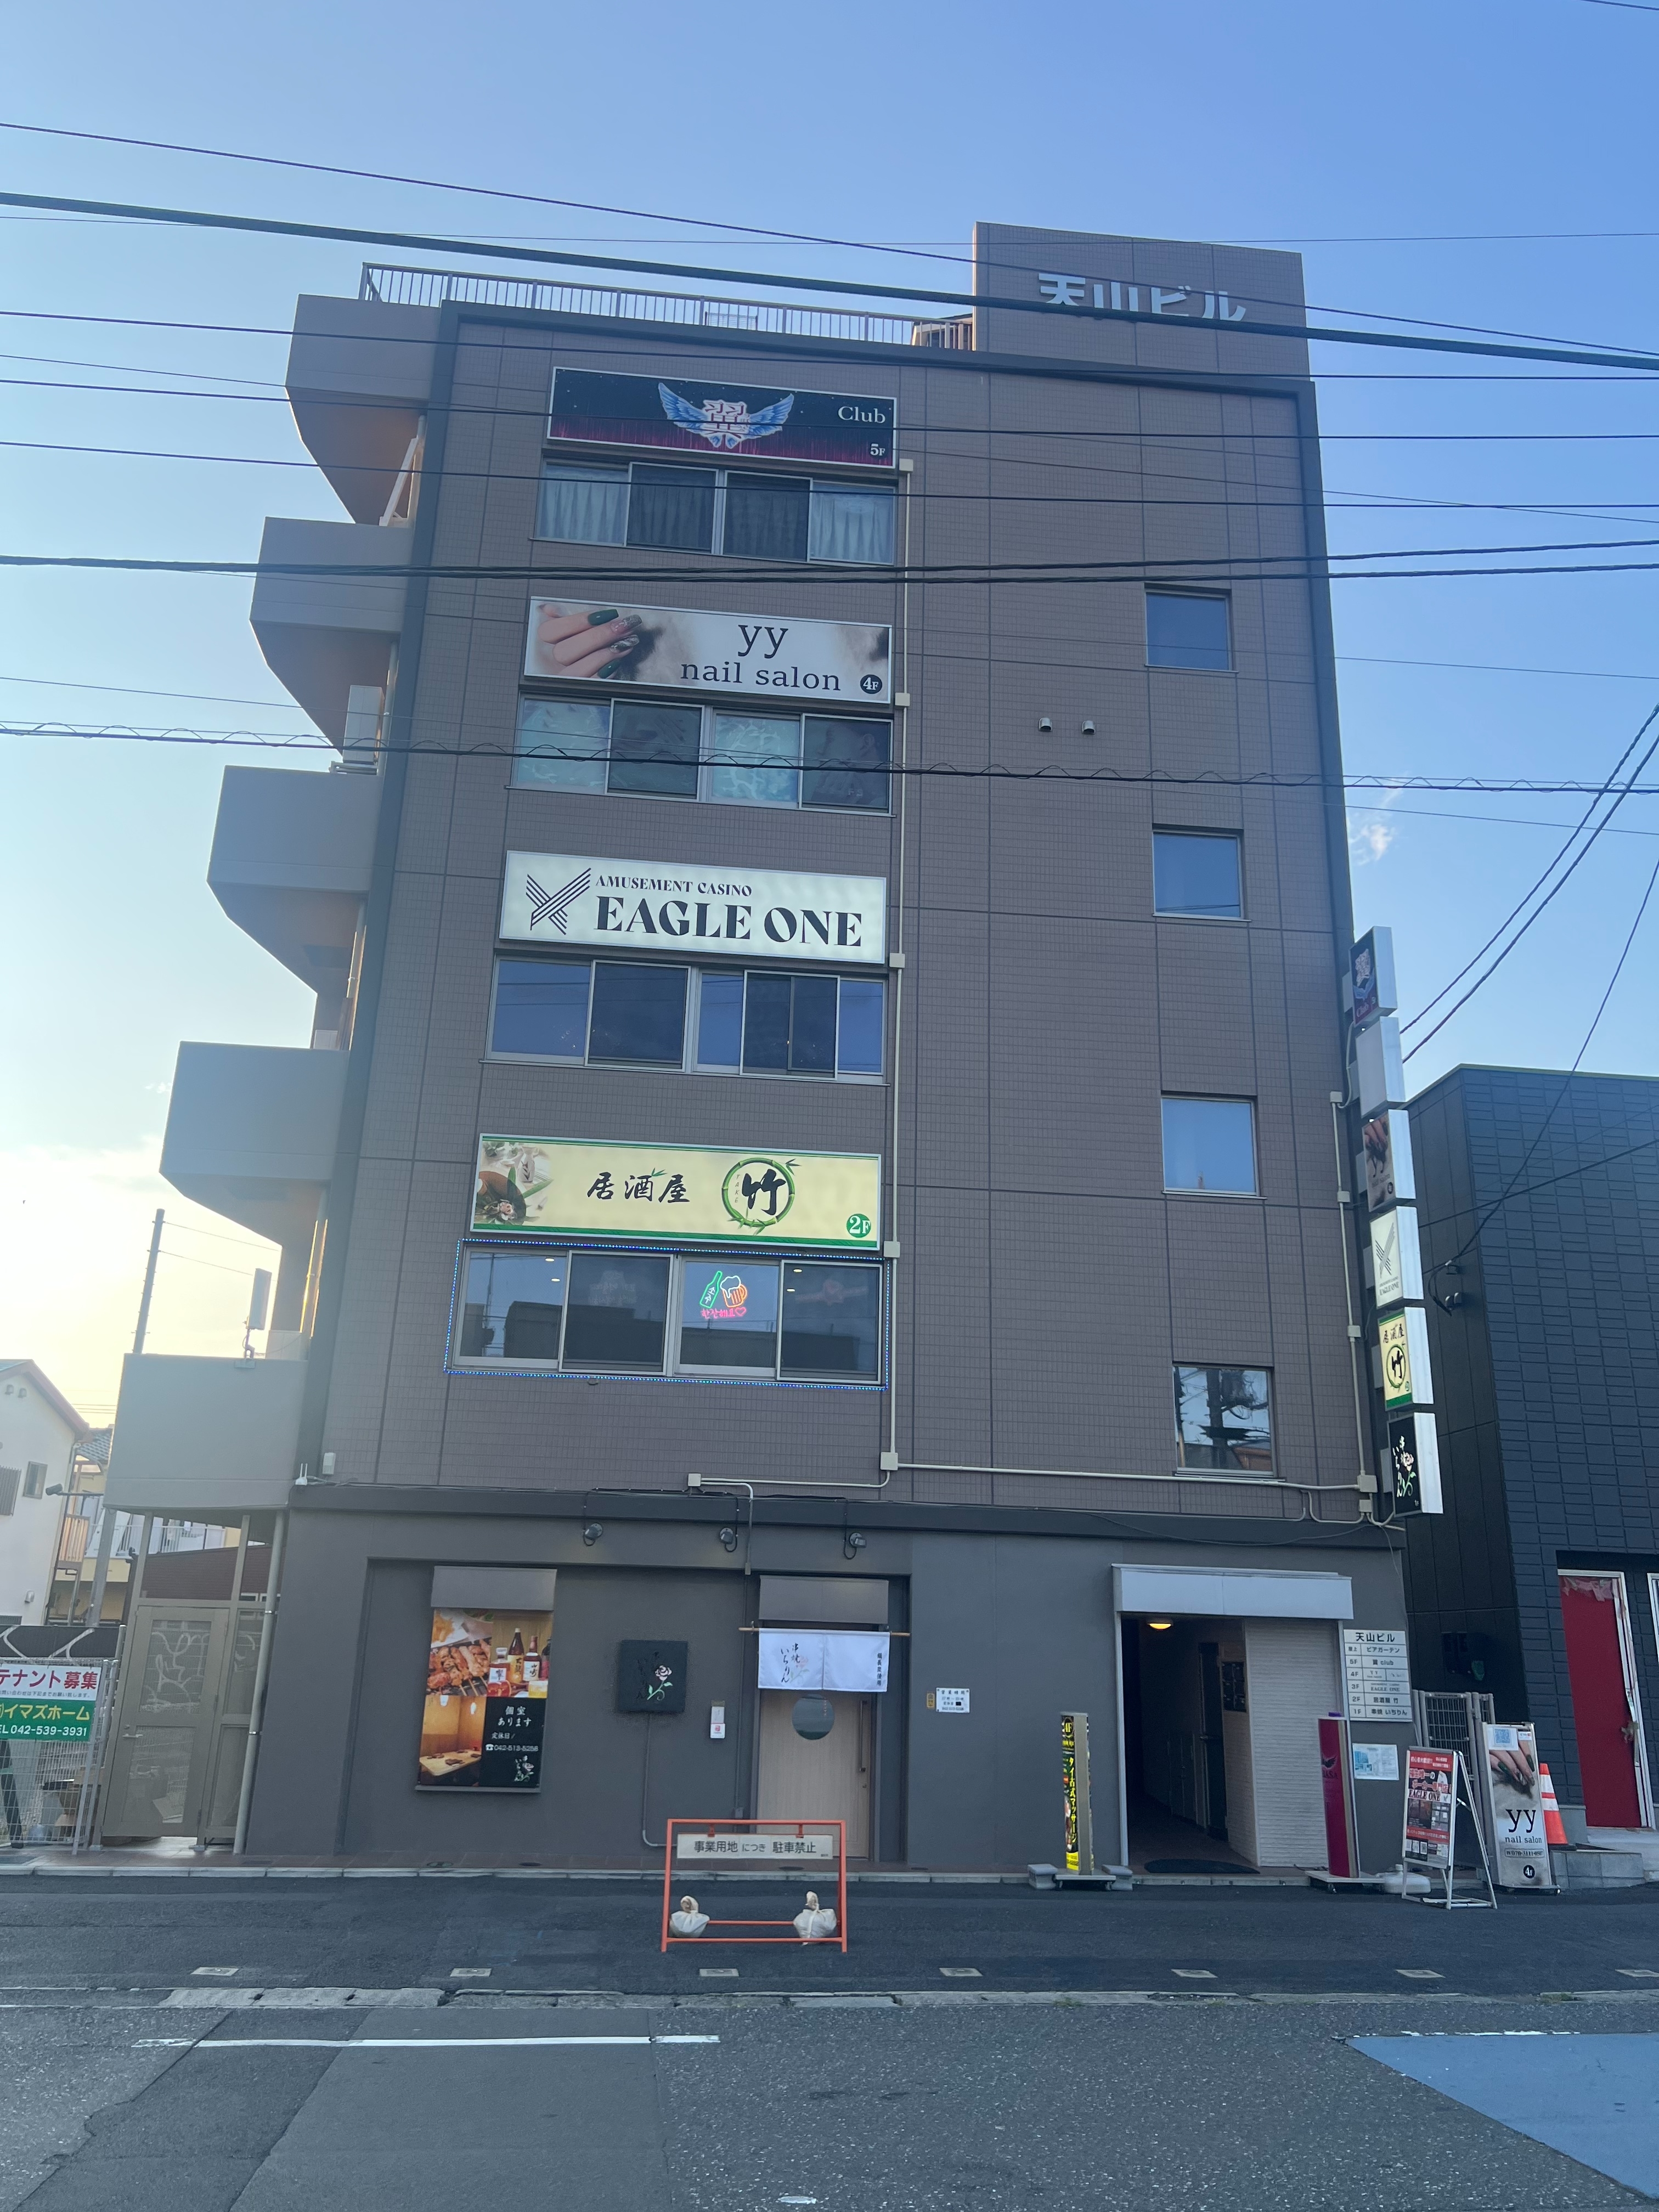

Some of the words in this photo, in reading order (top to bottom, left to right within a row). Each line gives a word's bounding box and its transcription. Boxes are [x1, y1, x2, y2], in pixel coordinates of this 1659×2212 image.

[1039, 273, 1246, 322] 天山ビル
[838, 406, 886, 424] Club
[870, 443, 886, 457] 5F
[738, 624, 788, 659] yy
[680, 661, 743, 684] nail
[755, 666, 841, 691] salon
[862, 677, 879, 691] 4F
[595, 874, 693, 893] AMUSEMENT
[698, 882, 753, 897] CASINO
[593, 895, 753, 940] EAGLE
[764, 906, 862, 947] ONE
[586, 1171, 691, 1204] 居酒屋
[741, 1168, 786, 1216] 竹
[849, 1215, 871, 1234] 2F
[1355, 1632, 1395, 1643] 天山ビル
[0, 1669, 98, 1690] テナント募集
[10, 1724, 87, 1736] 042-539-3931
[498, 1717, 532, 1727] あります
[1428, 1792, 1441, 1802] ONE
[1505, 1808, 1536, 1833] yy
[693, 1841, 738, 1853] 事業用地
[742, 1843, 766, 1853] につき
[772, 1841, 817, 1854] 駐車禁止
[1504, 1835, 1521, 1843] nail
